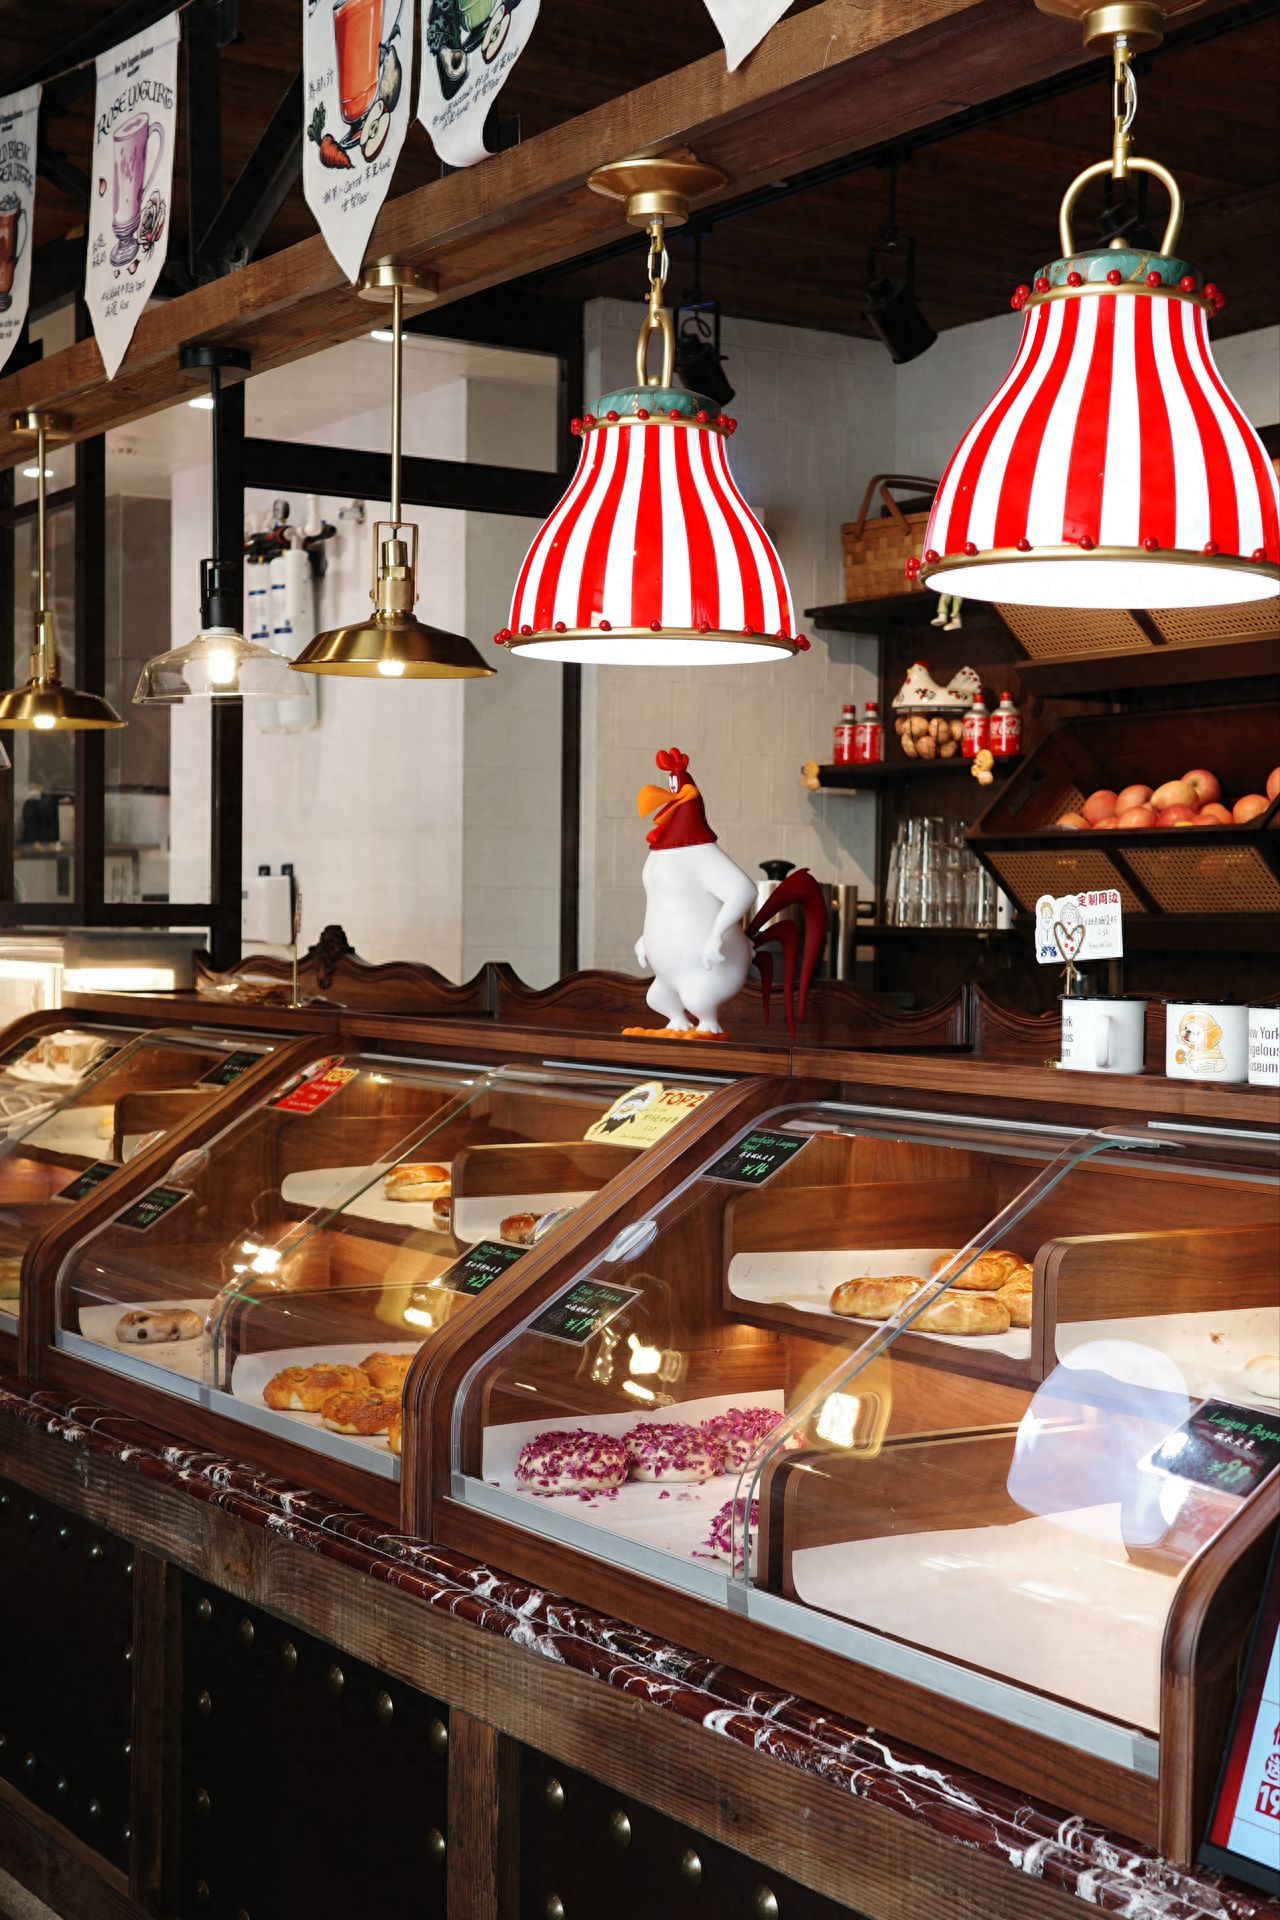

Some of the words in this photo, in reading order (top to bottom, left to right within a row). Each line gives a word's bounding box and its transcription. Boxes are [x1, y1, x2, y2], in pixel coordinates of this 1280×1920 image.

[1077, 891, 1119, 907] 定制周边
[658, 1091, 706, 1109] TOP2
[1249, 1423, 1280, 1442] Bage
